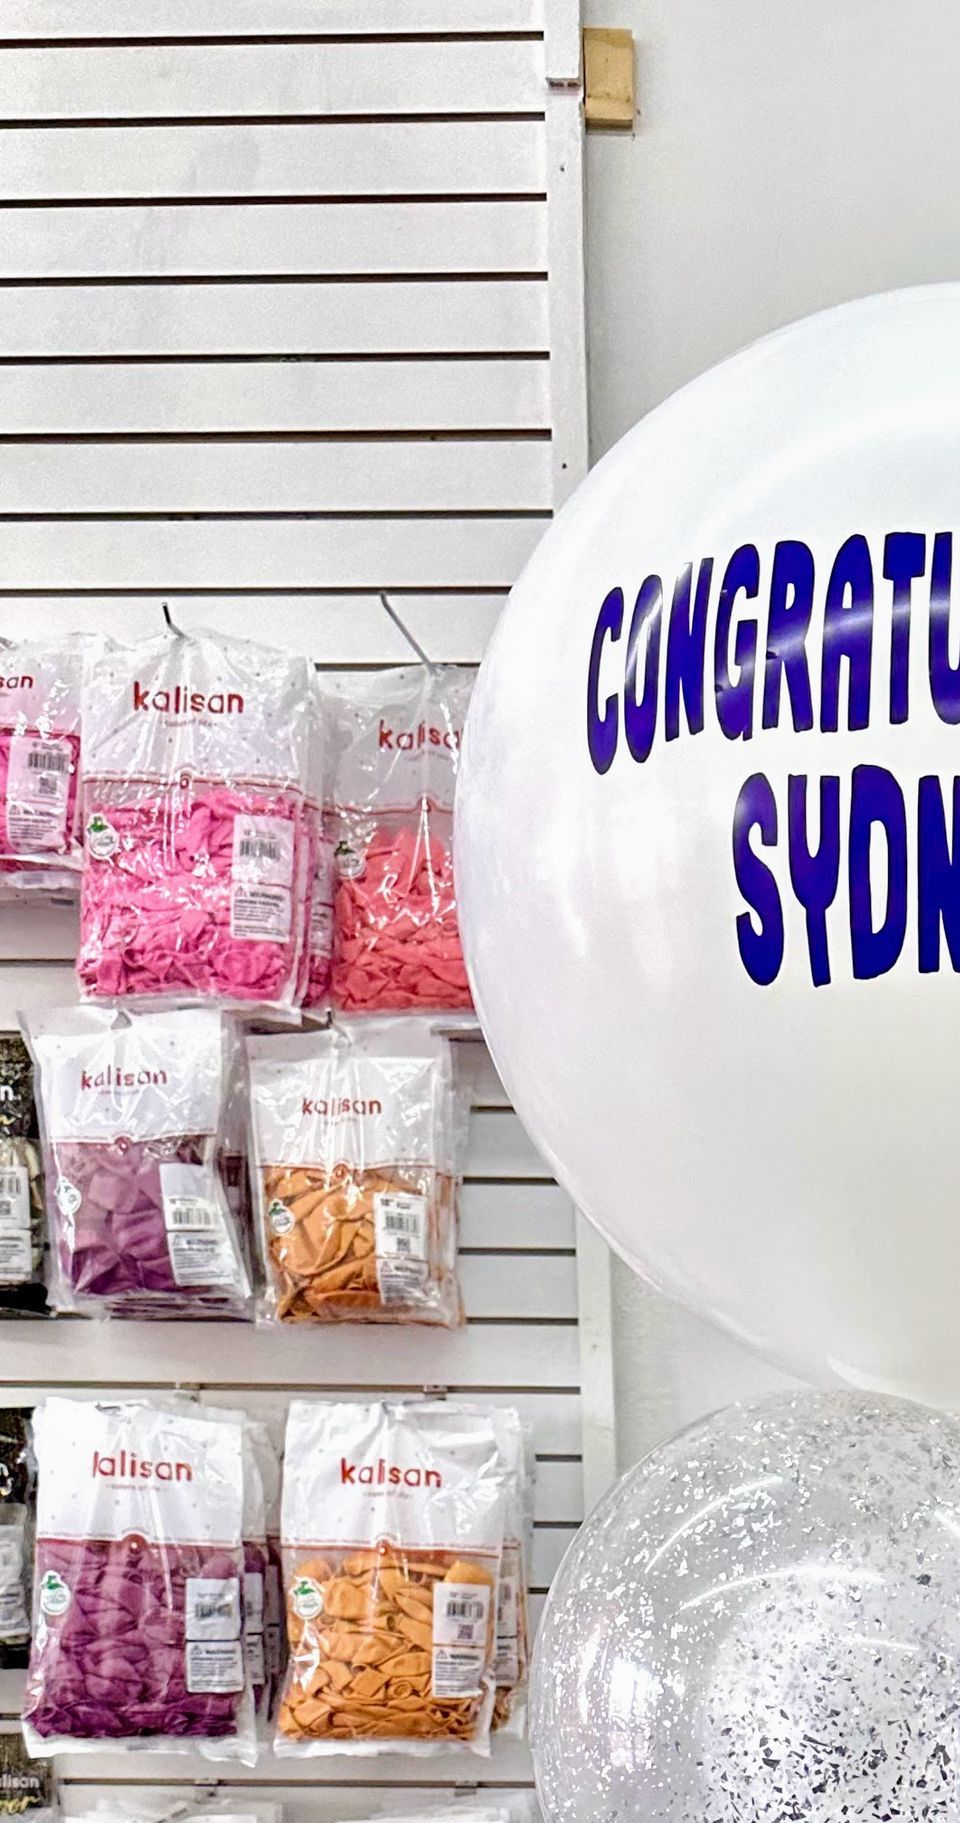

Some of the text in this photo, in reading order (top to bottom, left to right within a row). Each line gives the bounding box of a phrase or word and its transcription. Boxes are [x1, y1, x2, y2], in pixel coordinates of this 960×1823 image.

[134, 680, 245, 714] kalisan
[379, 719, 464, 751] kalisa
[81, 1063, 168, 1092] kalisan
[302, 1097, 382, 1117] kalisan
[0, 1773, 40, 1789] lisan
